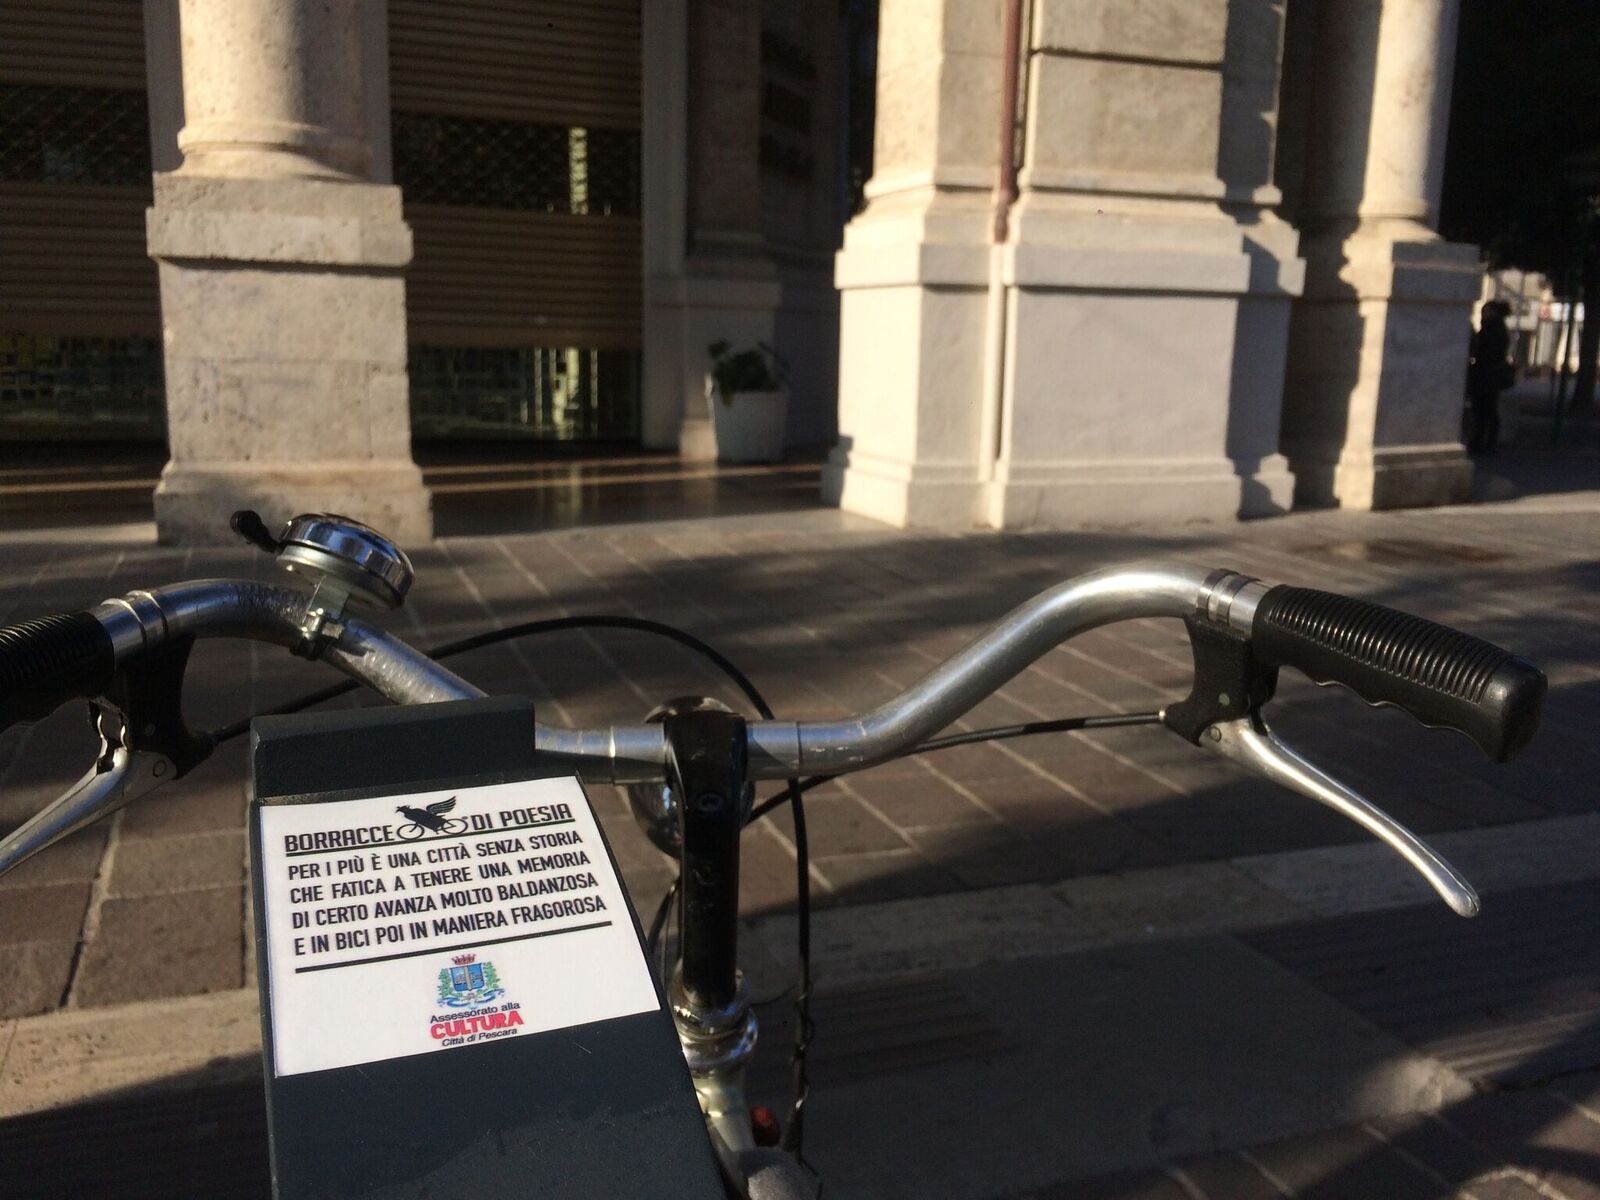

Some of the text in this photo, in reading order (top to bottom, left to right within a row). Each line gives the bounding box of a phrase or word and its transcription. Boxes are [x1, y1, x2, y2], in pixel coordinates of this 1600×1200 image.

[285, 803, 573, 852] BORRACCE DI POESIA
[288, 830, 583, 881] PER I PIÙ È UNA CITTÀ SENZA STORIA
[290, 850, 591, 904] CHE FATICA A TENERE UNA MEMORIA
[292, 872, 599, 929] DI CERTO AVANZA MOLTO BALDANZOSA
[294, 895, 607, 956] E IN BICI POI IN MANIERA FRAGOROSA
[430, 1002, 521, 1024] Assessorato alla
[430, 1010, 524, 1040] CULTURA
[442, 1028, 518, 1047] Città di Pescara
